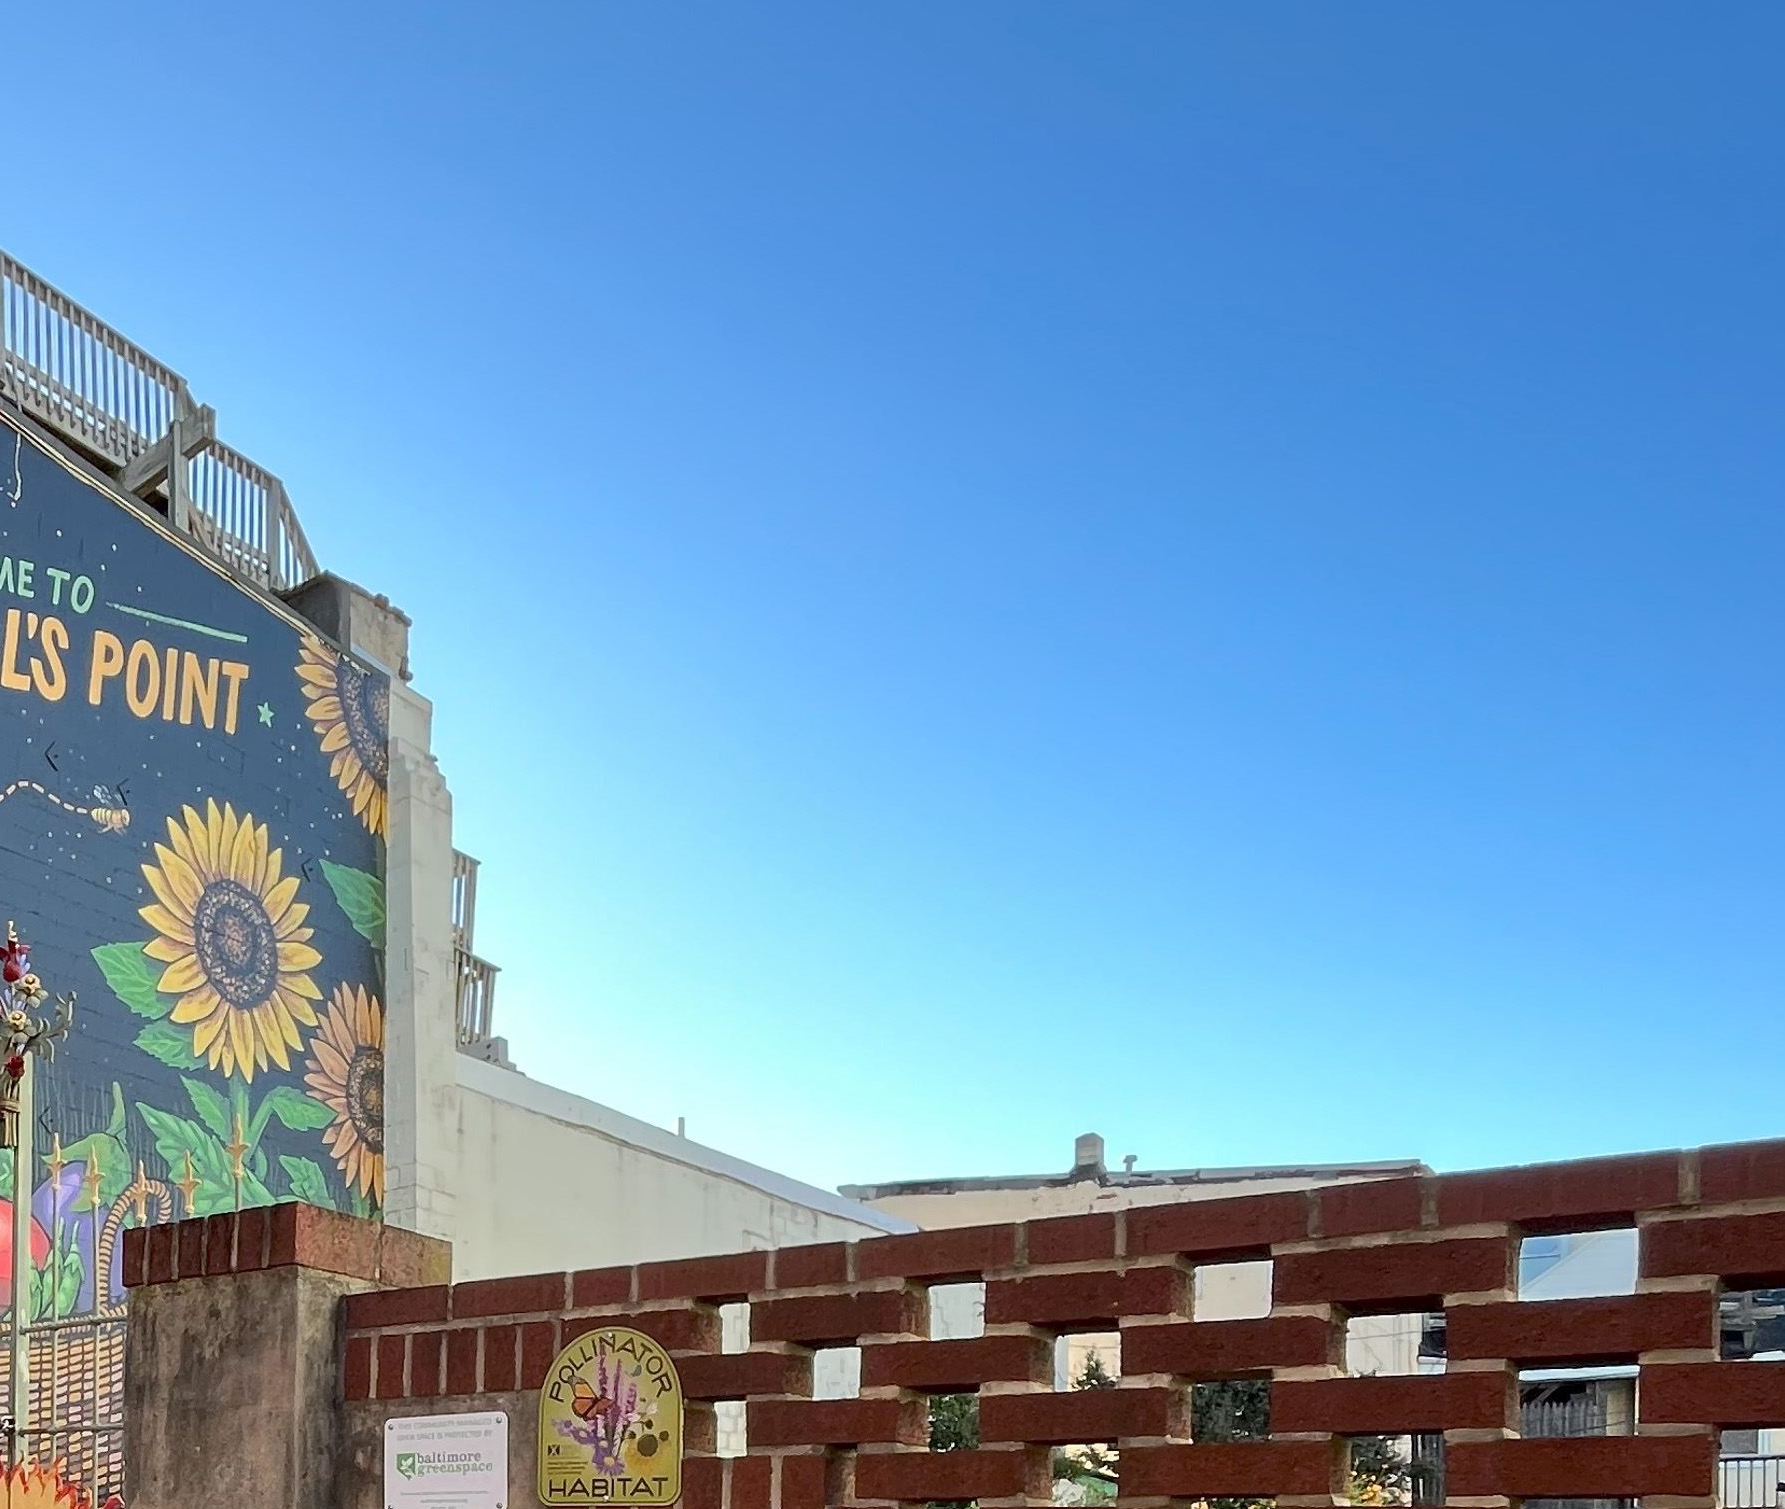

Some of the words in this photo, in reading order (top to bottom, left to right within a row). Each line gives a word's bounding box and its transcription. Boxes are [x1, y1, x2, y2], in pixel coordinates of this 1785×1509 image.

[47, 566, 95, 614] TO
[89, 629, 250, 734] POINT
[548, 1333, 672, 1402] POLLINATOR
[417, 1451, 481, 1464] baltimore
[417, 1462, 493, 1477] greenspace
[548, 1477, 668, 1497] HABITAT
